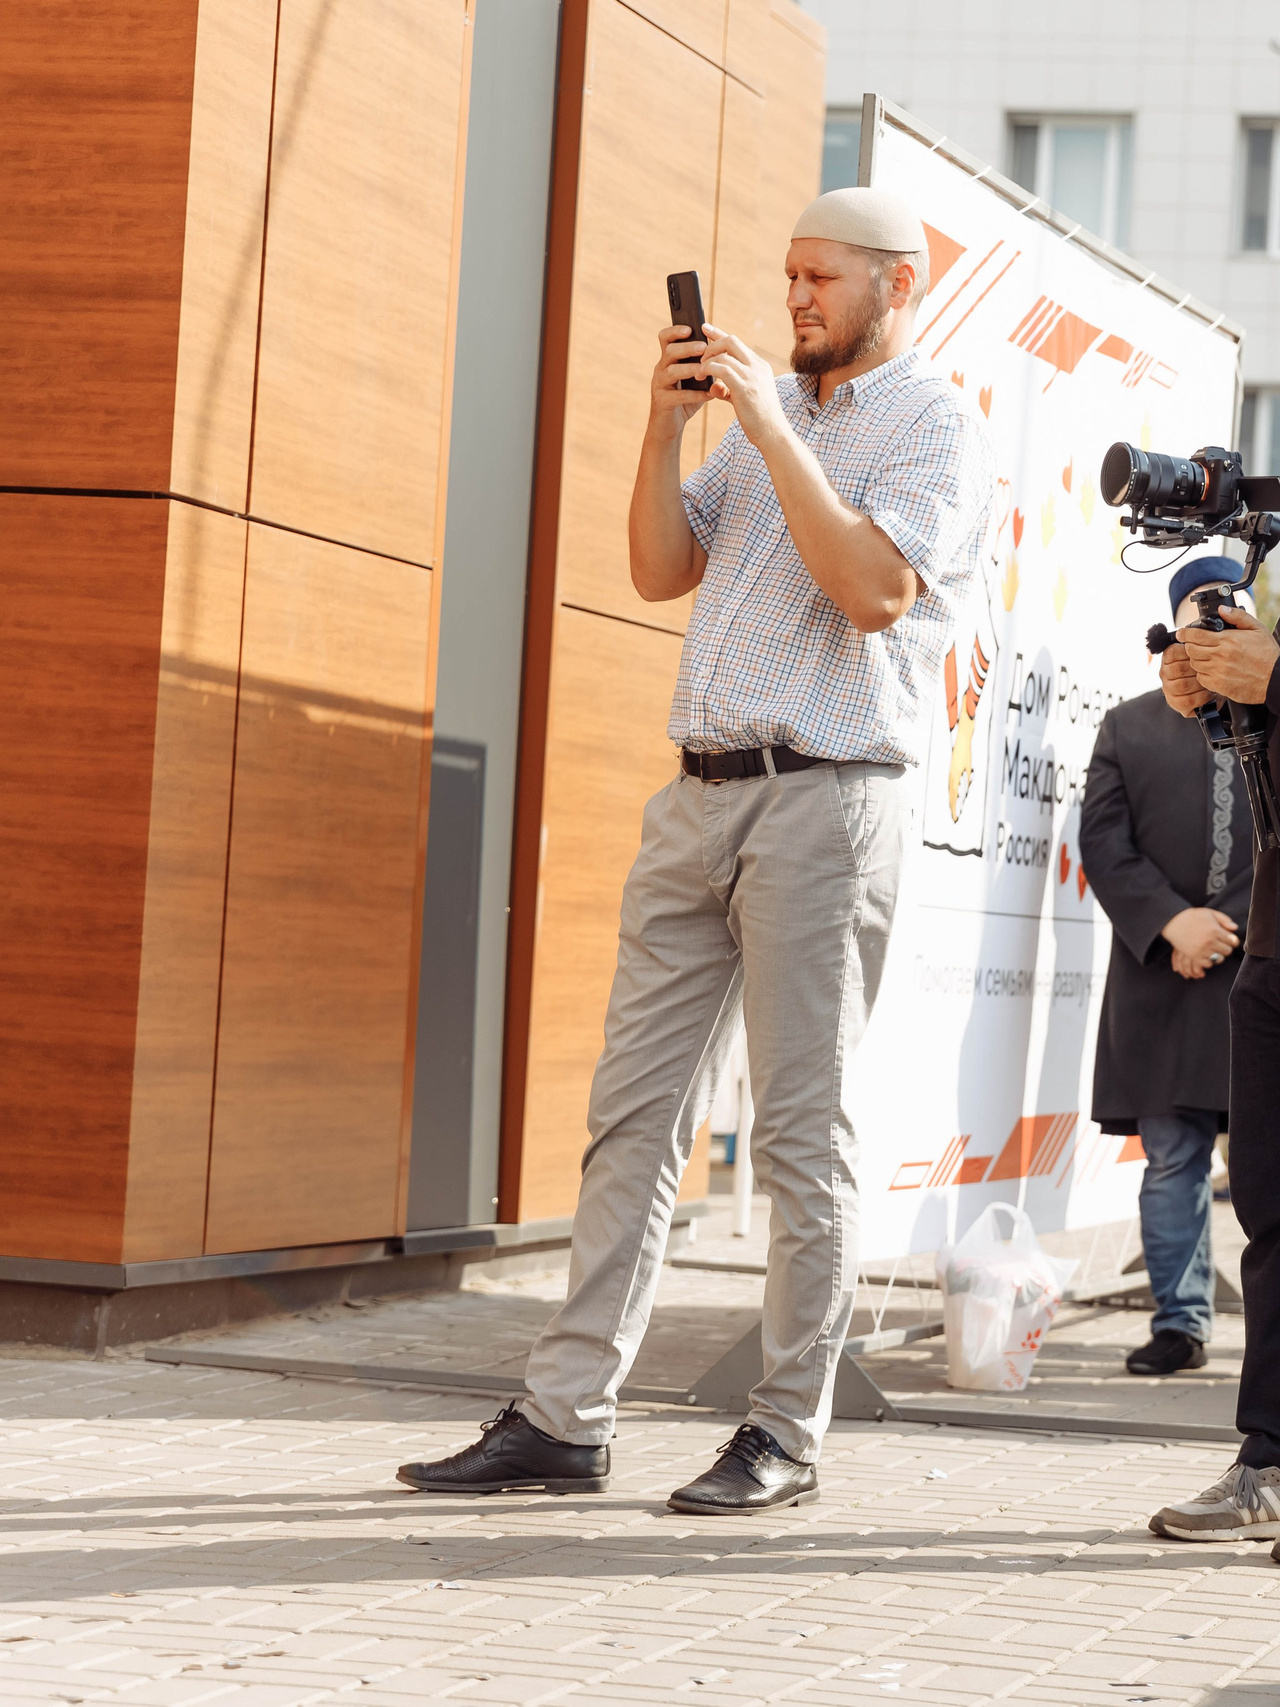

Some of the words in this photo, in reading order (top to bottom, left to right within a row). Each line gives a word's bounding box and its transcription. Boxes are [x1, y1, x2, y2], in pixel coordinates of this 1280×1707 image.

[1006, 653, 1051, 726] Дом
[1057, 665, 1123, 728] Рона
[995, 821, 1048, 869] Россия
[913, 954, 982, 995] Помогаем
[986, 966, 1034, 997] семьям
